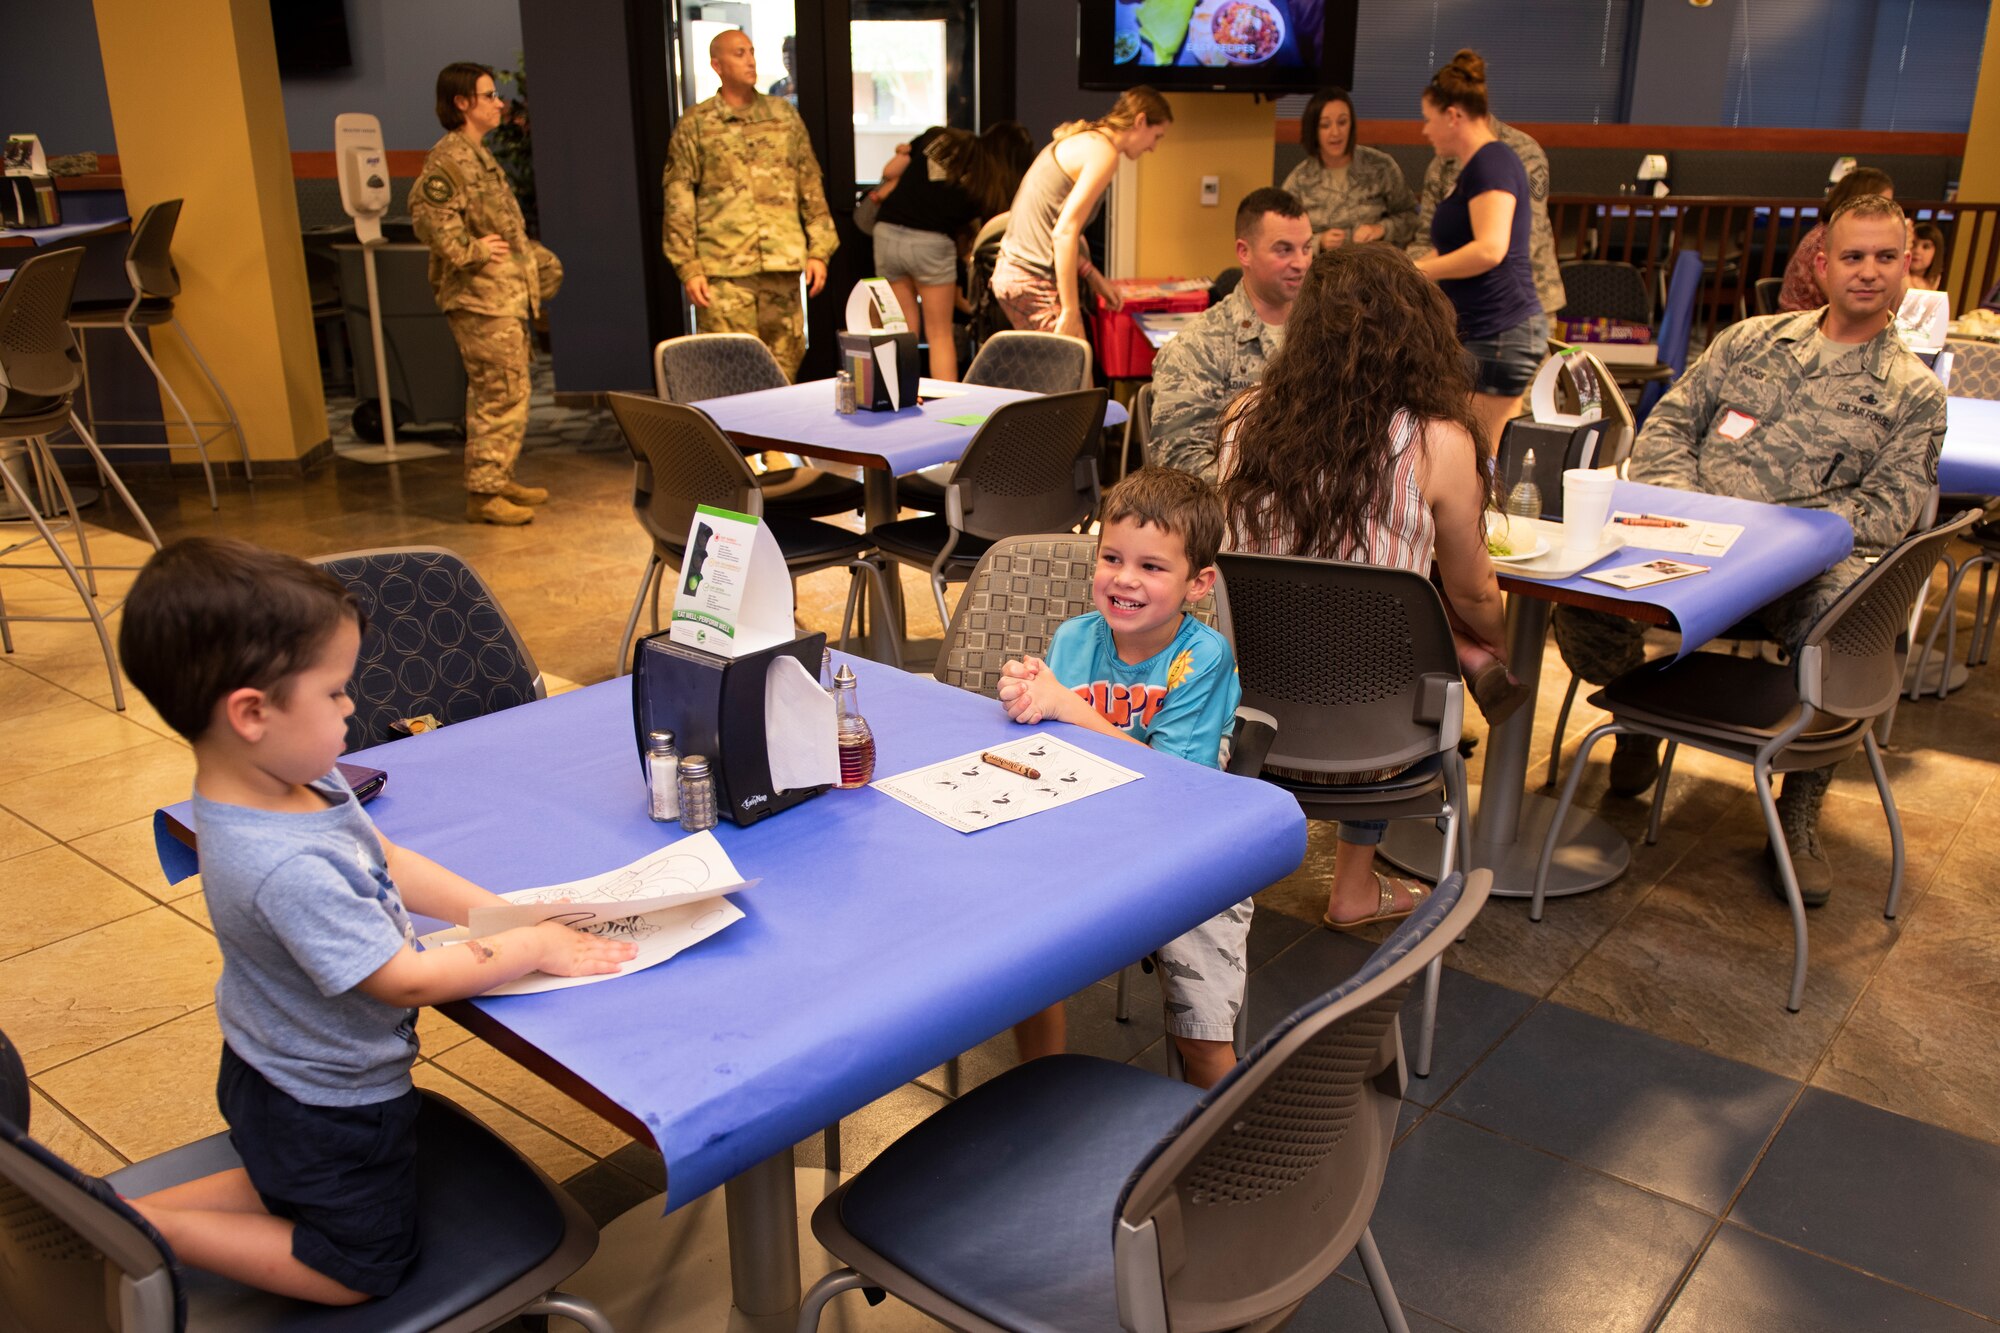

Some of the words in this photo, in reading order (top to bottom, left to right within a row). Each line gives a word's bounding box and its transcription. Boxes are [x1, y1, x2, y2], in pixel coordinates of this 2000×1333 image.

[1215, 43, 1256, 54] RECIPES
[1850, 404, 1865, 416] AIR
[1866, 410, 1890, 427] FORCE
[677, 610, 686, 618] EAT
[686, 612, 697, 621] WELL
[698, 615, 719, 628] PERFORM
[719, 622, 730, 633] WELL
